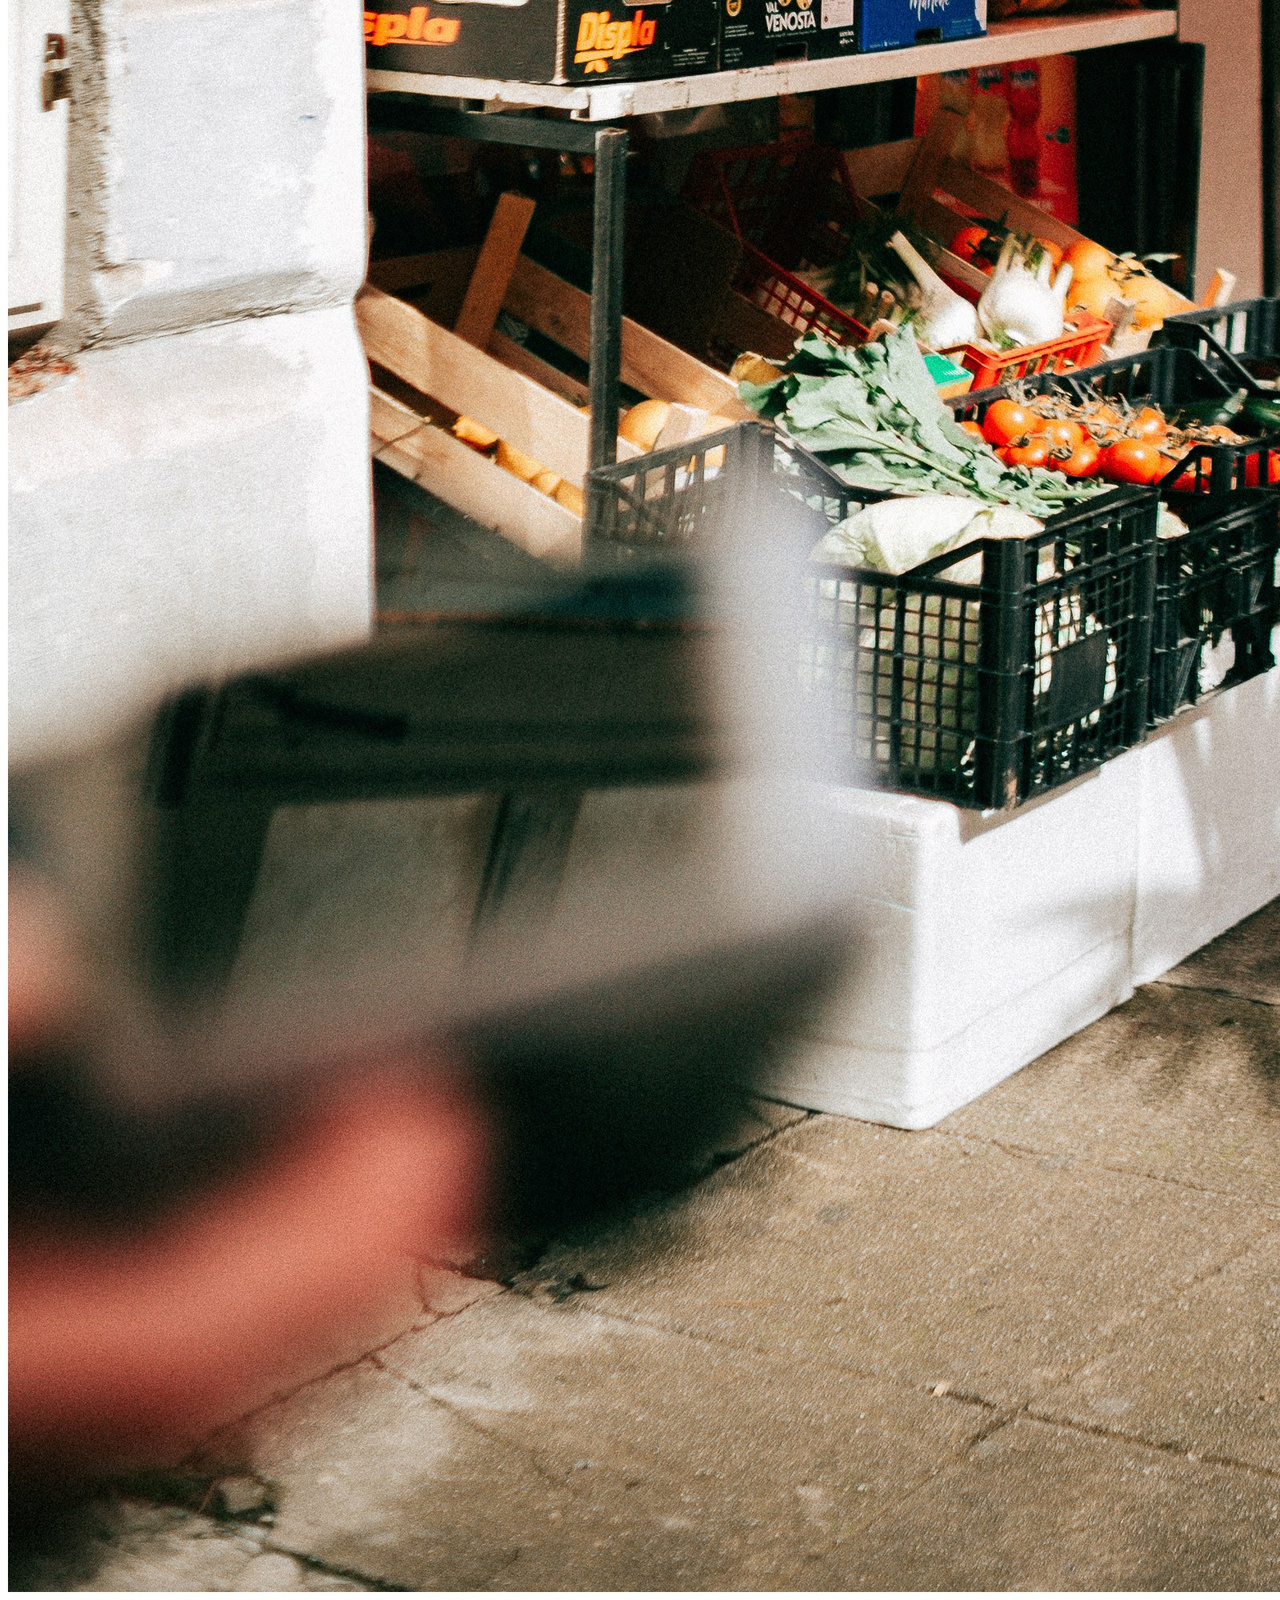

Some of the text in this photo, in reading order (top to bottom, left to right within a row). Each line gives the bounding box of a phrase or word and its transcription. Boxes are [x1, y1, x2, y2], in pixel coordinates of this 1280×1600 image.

[765, 1, 780, 14] VAL
[765, 10, 817, 33] VENOSTA
[363, 6, 461, 46] spla
[576, 9, 657, 60] Displa
